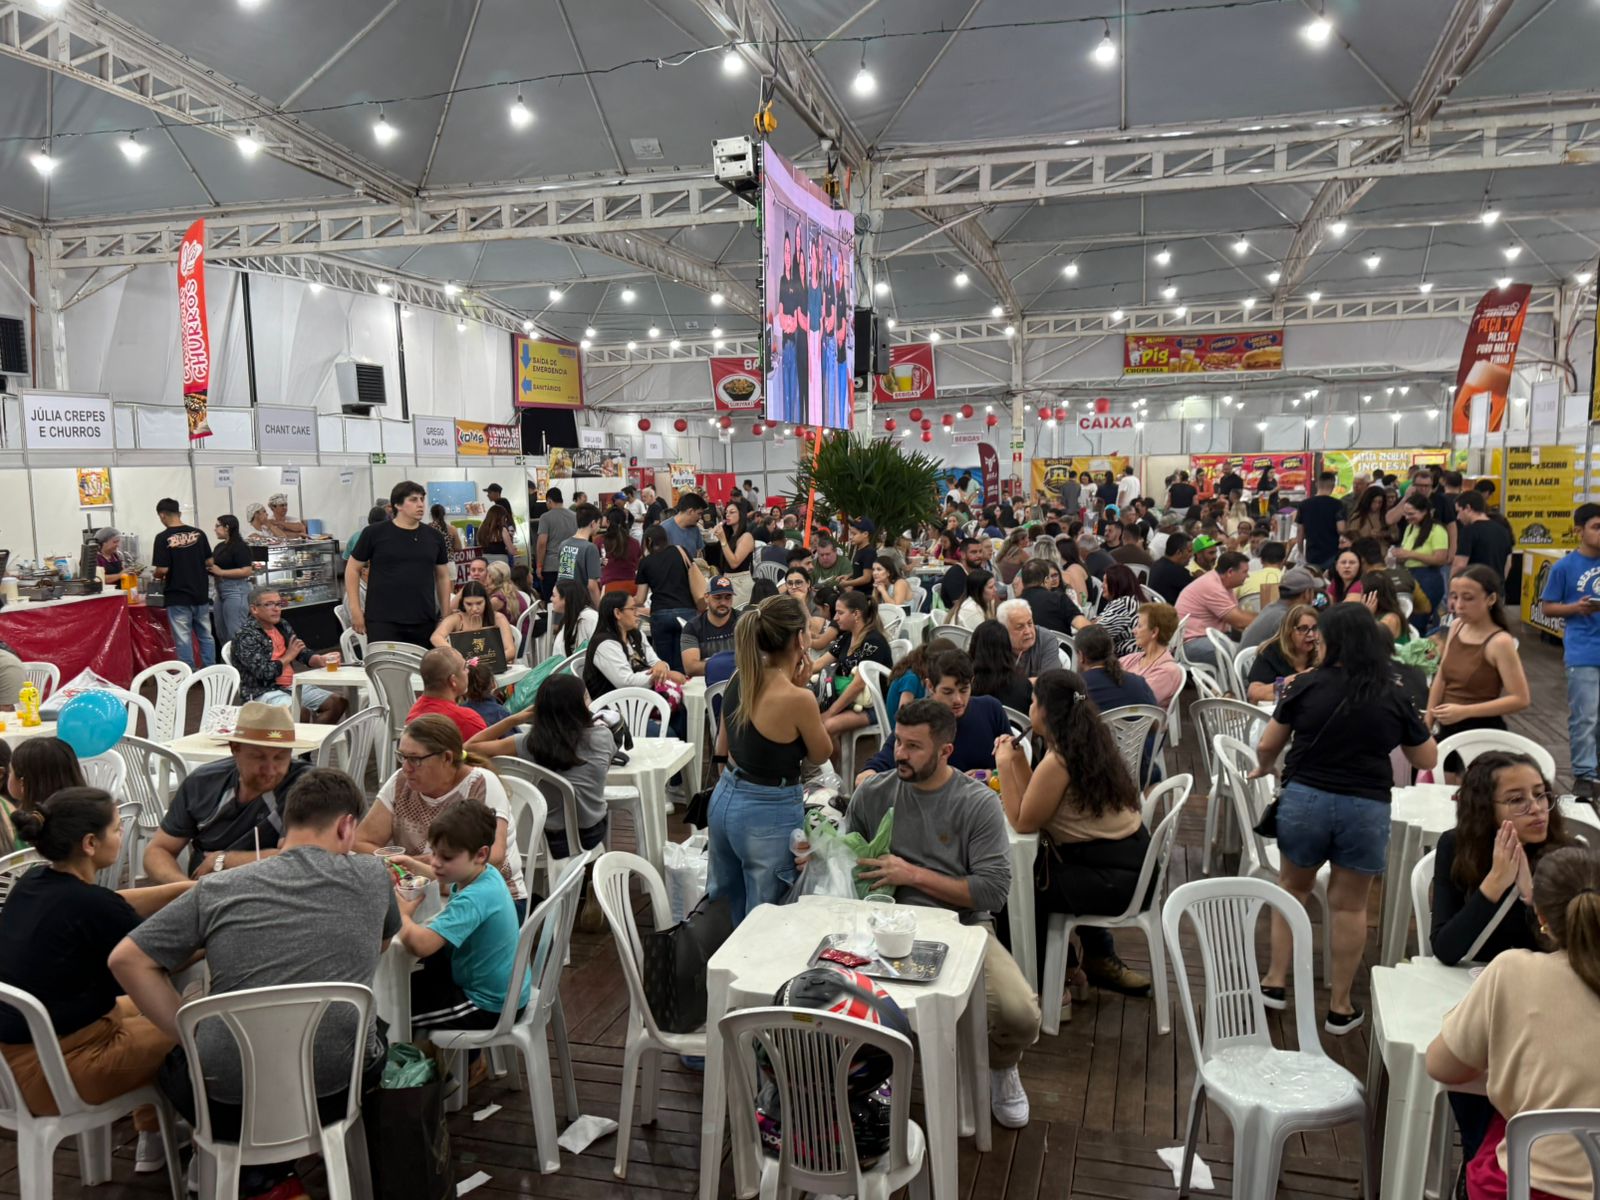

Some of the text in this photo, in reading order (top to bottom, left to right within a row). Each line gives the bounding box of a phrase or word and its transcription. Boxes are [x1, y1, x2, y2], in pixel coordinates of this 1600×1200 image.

[184, 279, 208, 383] CHURROS
[30, 405, 106, 422] JÚLIA CREPES
[1079, 416, 1134, 430] CAIXA
[39, 426, 102, 438] E CHURROS
[265, 424, 311, 436] CHANT CAKE
[425, 426, 445, 436] GREGO
[487, 426, 510, 438] VENHA
[422, 437, 449, 447] NA CHAPA
[1508, 477, 1560, 487] VIENA LAGER
[1507, 494, 1521, 502] IPA
[1507, 510, 1571, 518] CHOPP DE VINHO
[466, 548, 476, 560] NA
